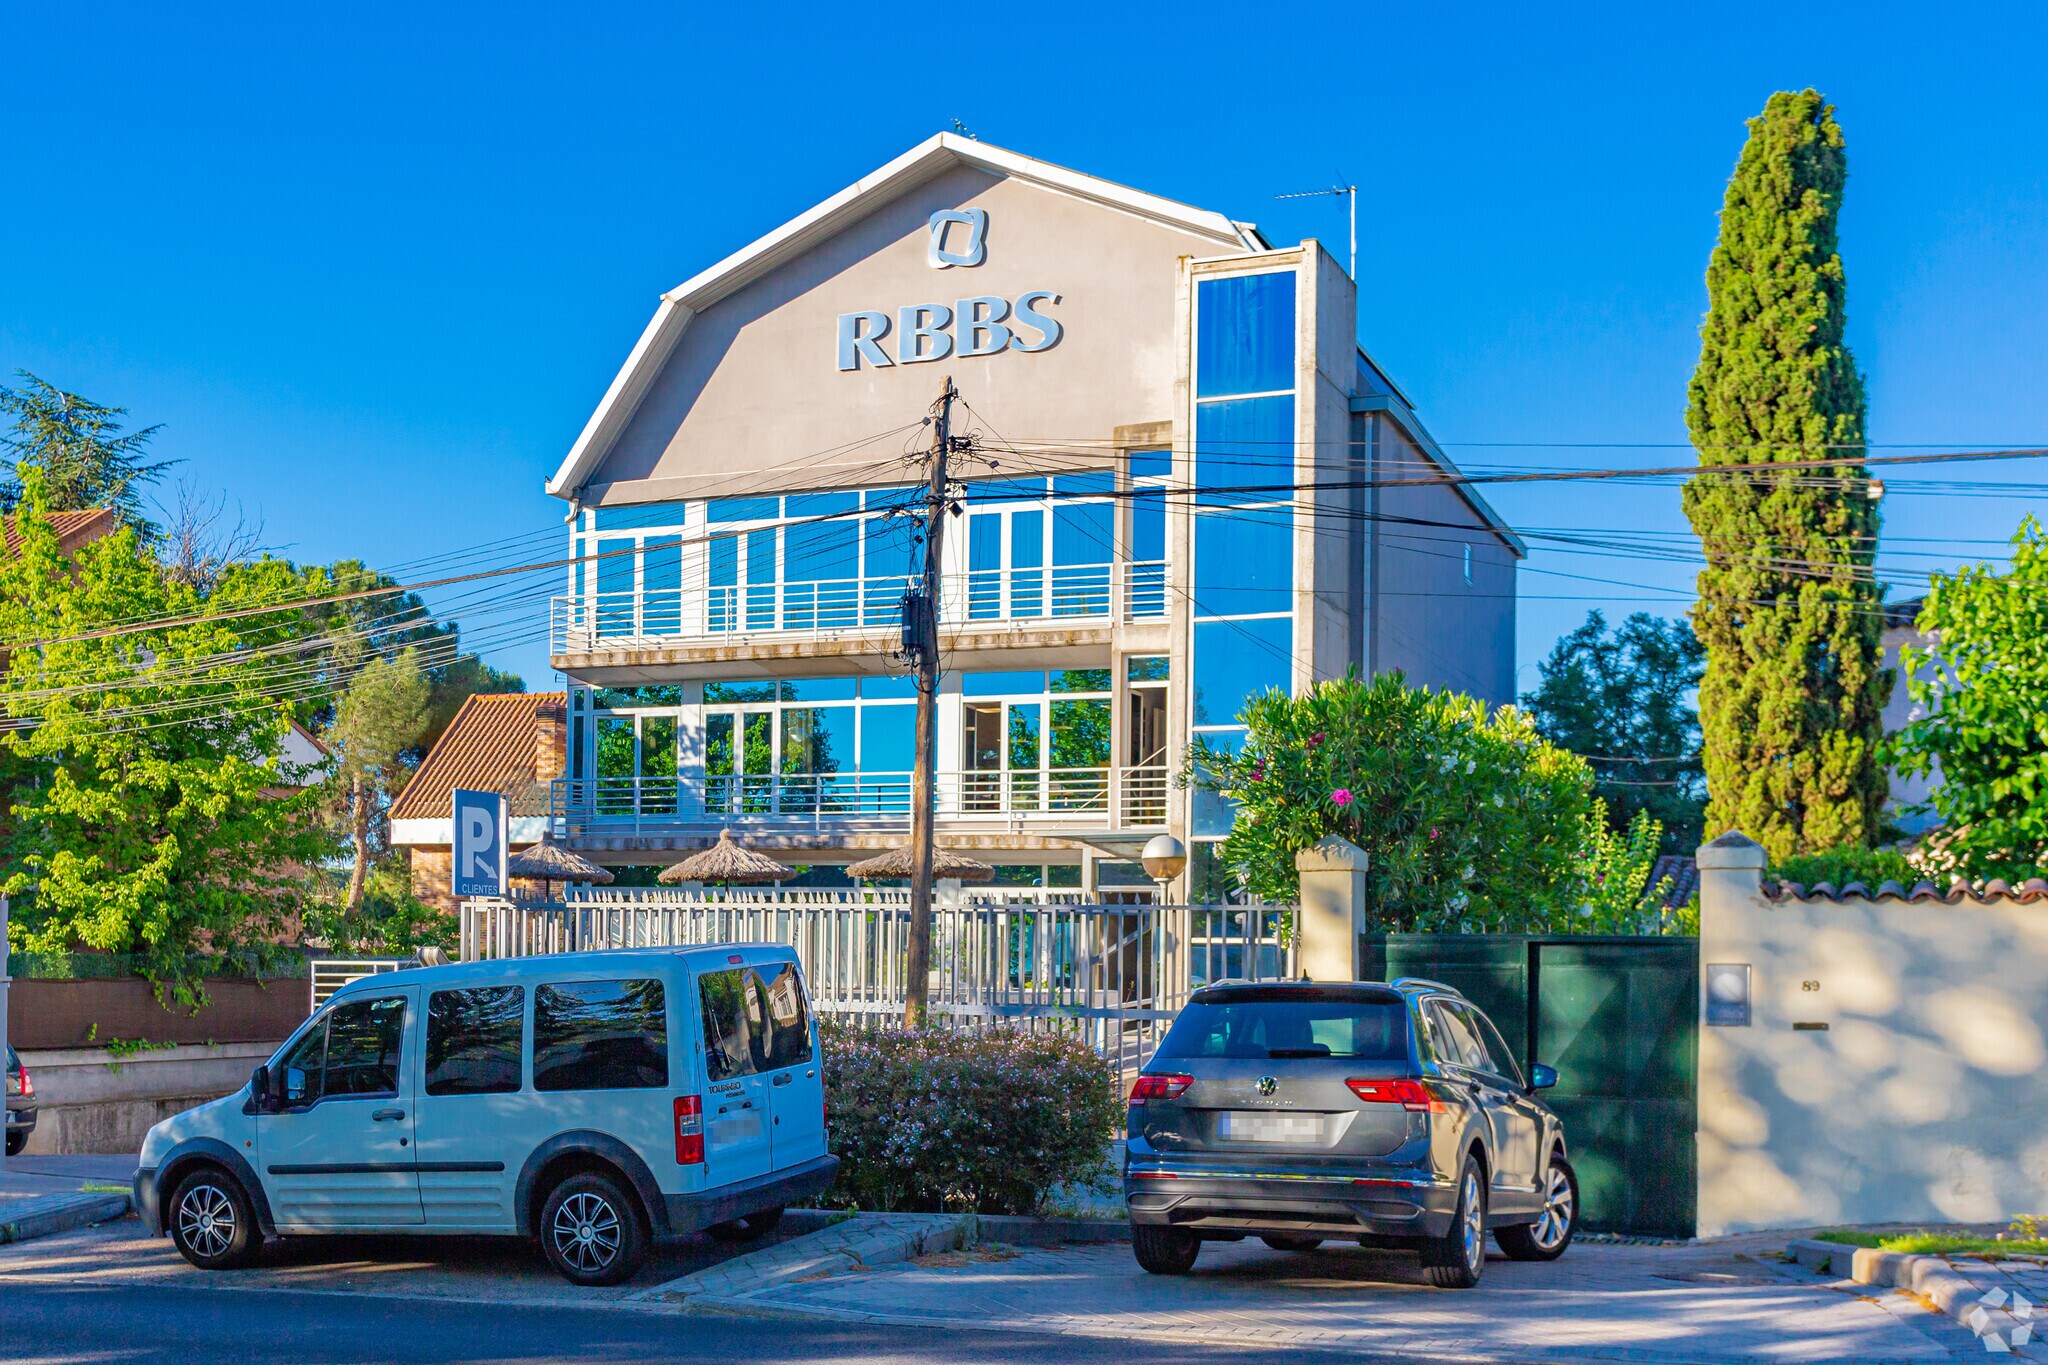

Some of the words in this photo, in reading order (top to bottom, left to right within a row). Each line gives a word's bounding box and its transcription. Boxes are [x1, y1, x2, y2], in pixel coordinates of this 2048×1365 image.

[838, 290, 1063, 371] RBBS
[462, 806, 494, 878] P
[461, 883, 498, 895] CLIENTES
[1802, 980, 1820, 992] 89
